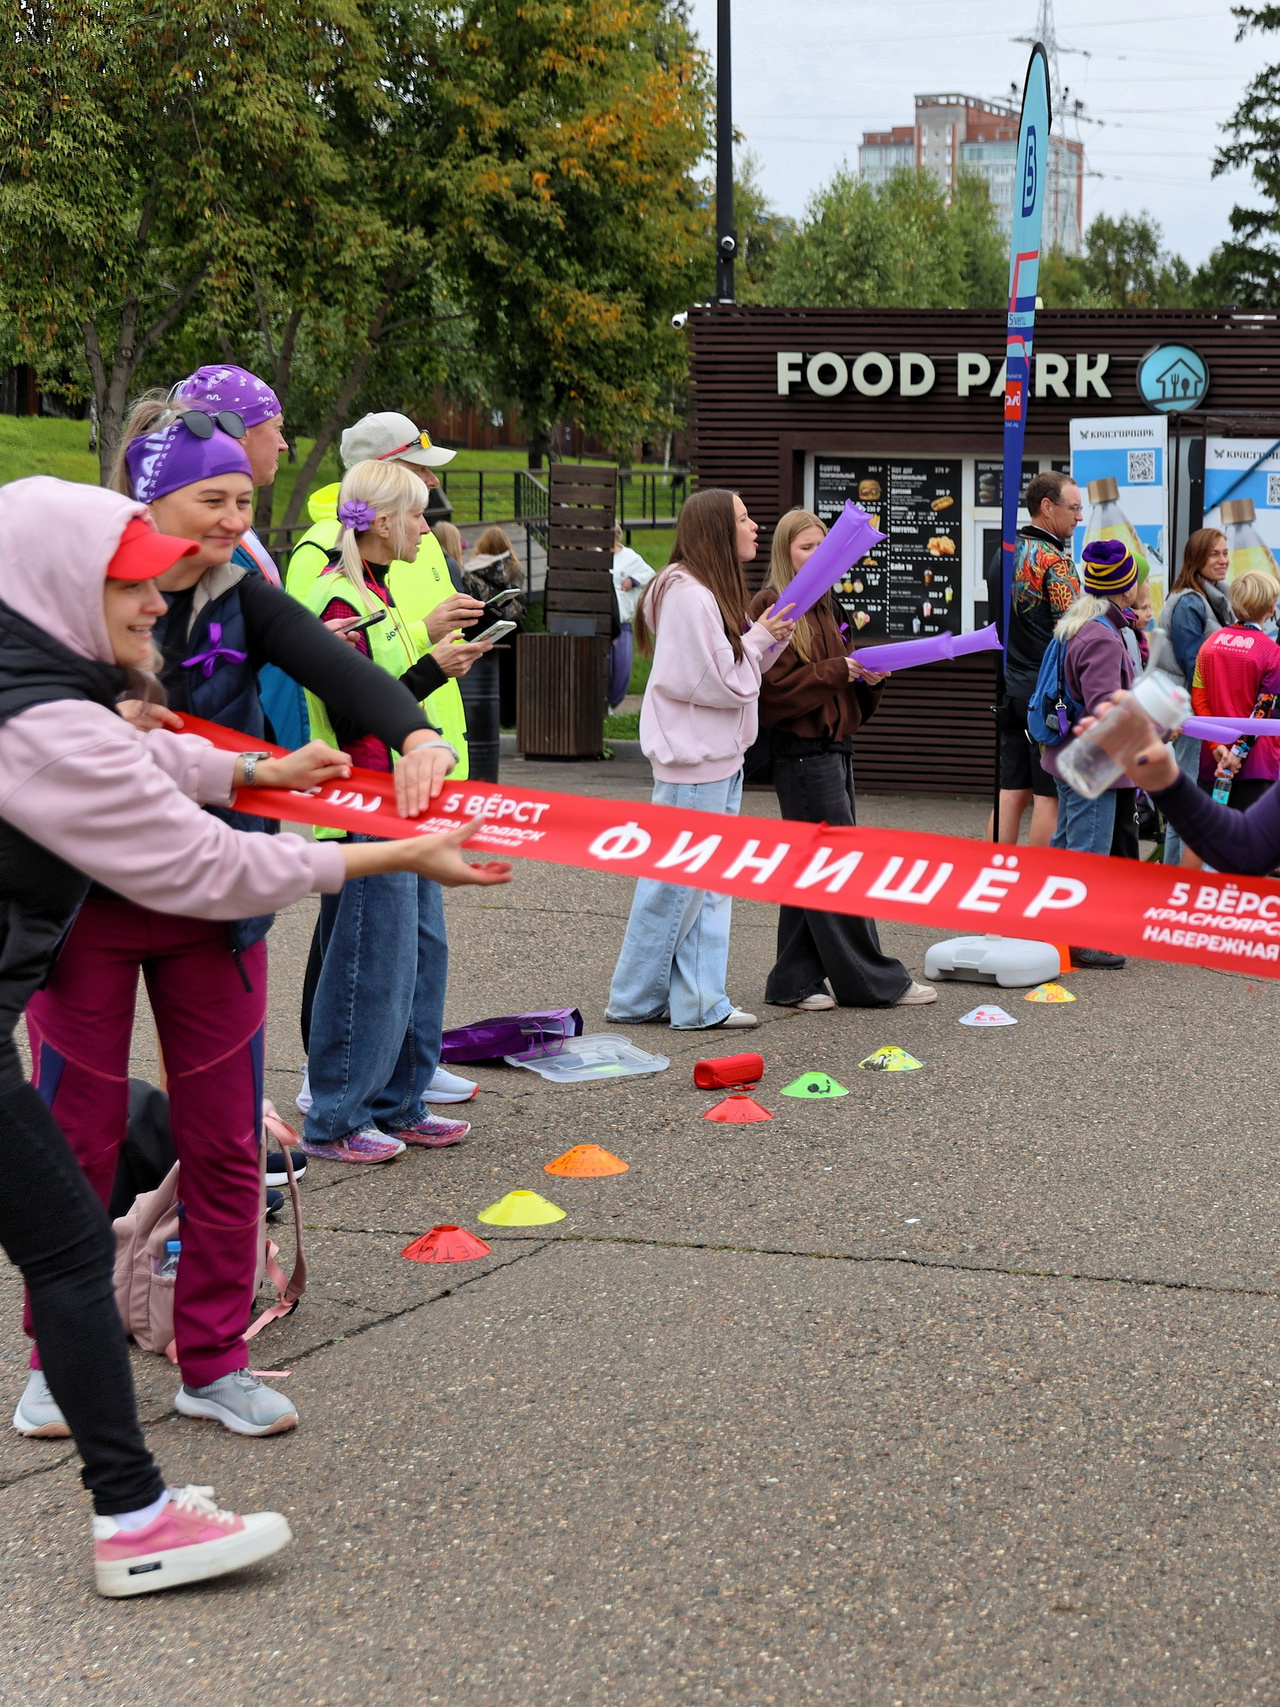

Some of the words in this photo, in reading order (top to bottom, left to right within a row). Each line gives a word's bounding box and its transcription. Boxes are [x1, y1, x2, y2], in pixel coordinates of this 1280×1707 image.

[777, 351, 936, 397] FOOD
[957, 352, 1112, 398] PRK
[1090, 429, 1154, 439] КРАСГОРПАРК
[443, 794, 464, 813] 5
[464, 794, 550, 824] ВЁРСТ
[588, 821, 1088, 918] ФИНИШЁР
[1168, 882, 1190, 907] 5
[1142, 925, 1280, 962] НАБЕРЕЖНАЯ
